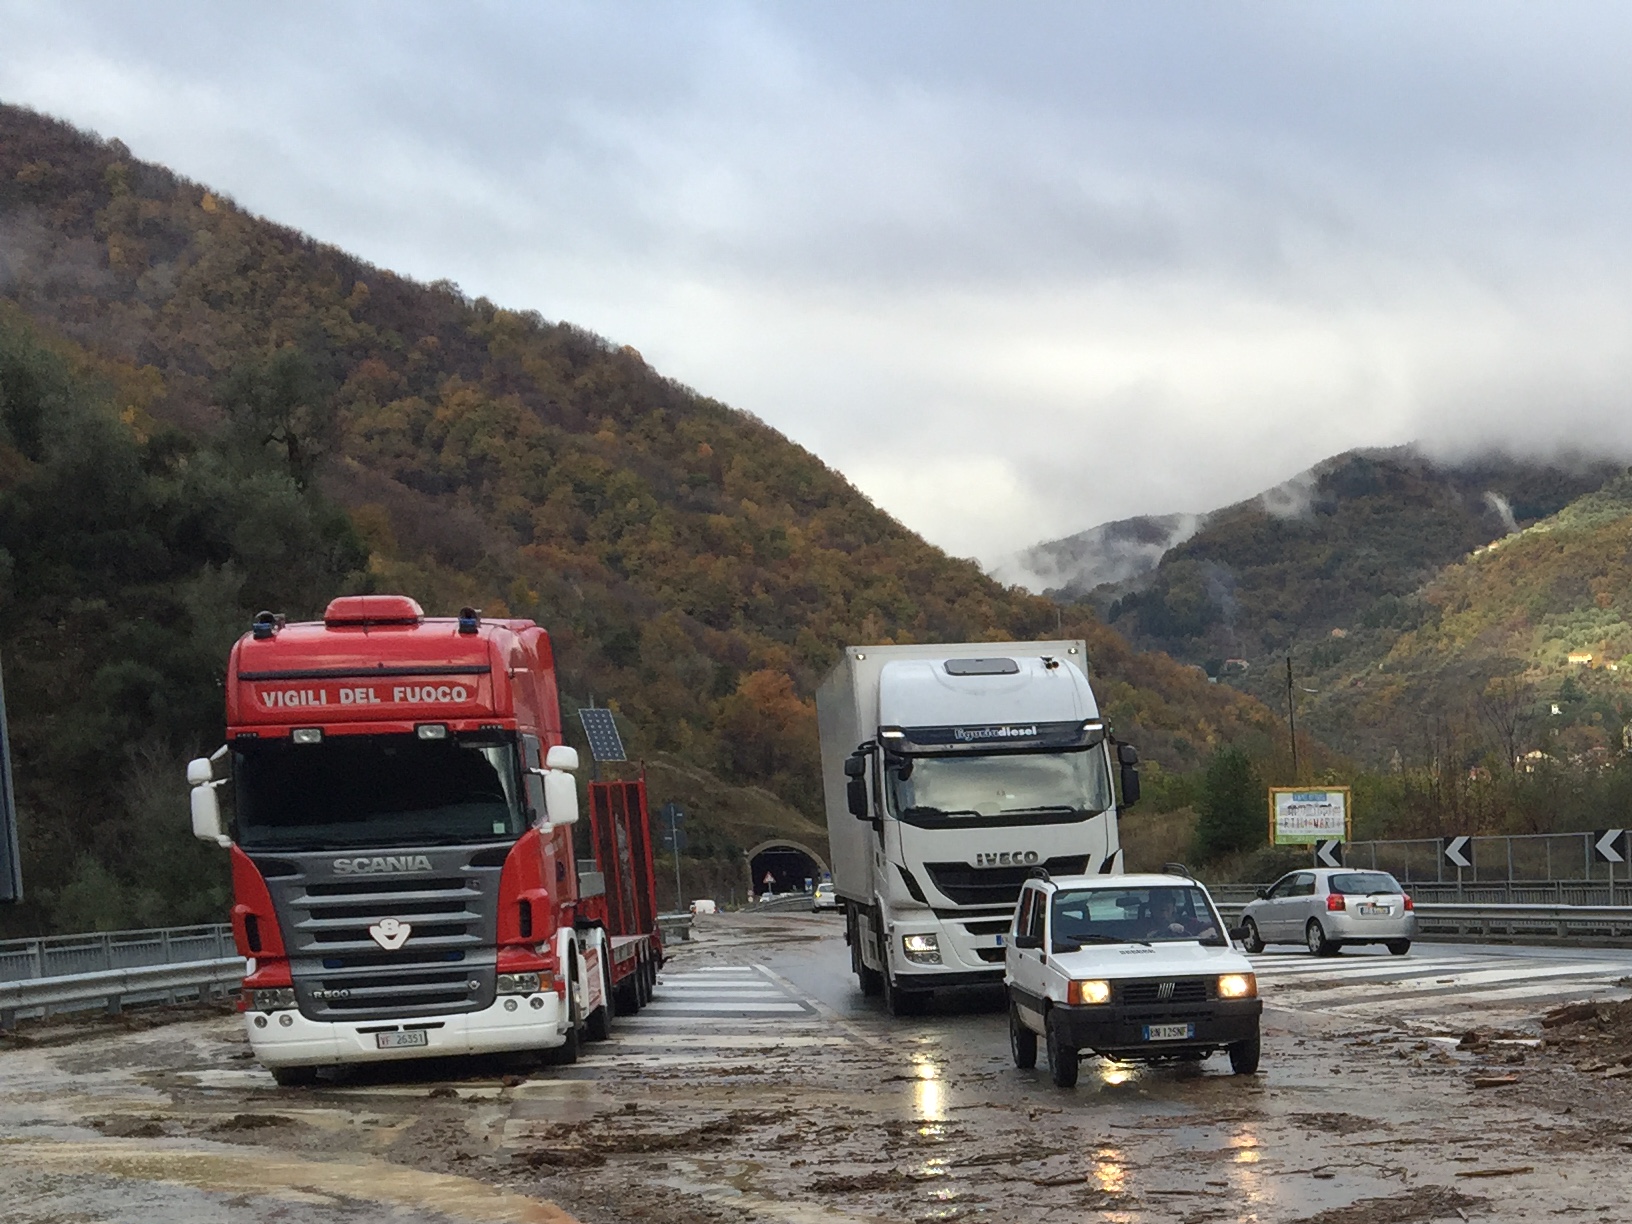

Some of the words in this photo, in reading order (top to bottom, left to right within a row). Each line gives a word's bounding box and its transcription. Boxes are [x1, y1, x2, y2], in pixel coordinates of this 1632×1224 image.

[261, 689, 327, 708] VIGILI
[339, 687, 381, 705] DEL
[393, 685, 467, 704] FUOCO
[333, 855, 433, 874] SCANIA
[976, 850, 1039, 867] IVECO
